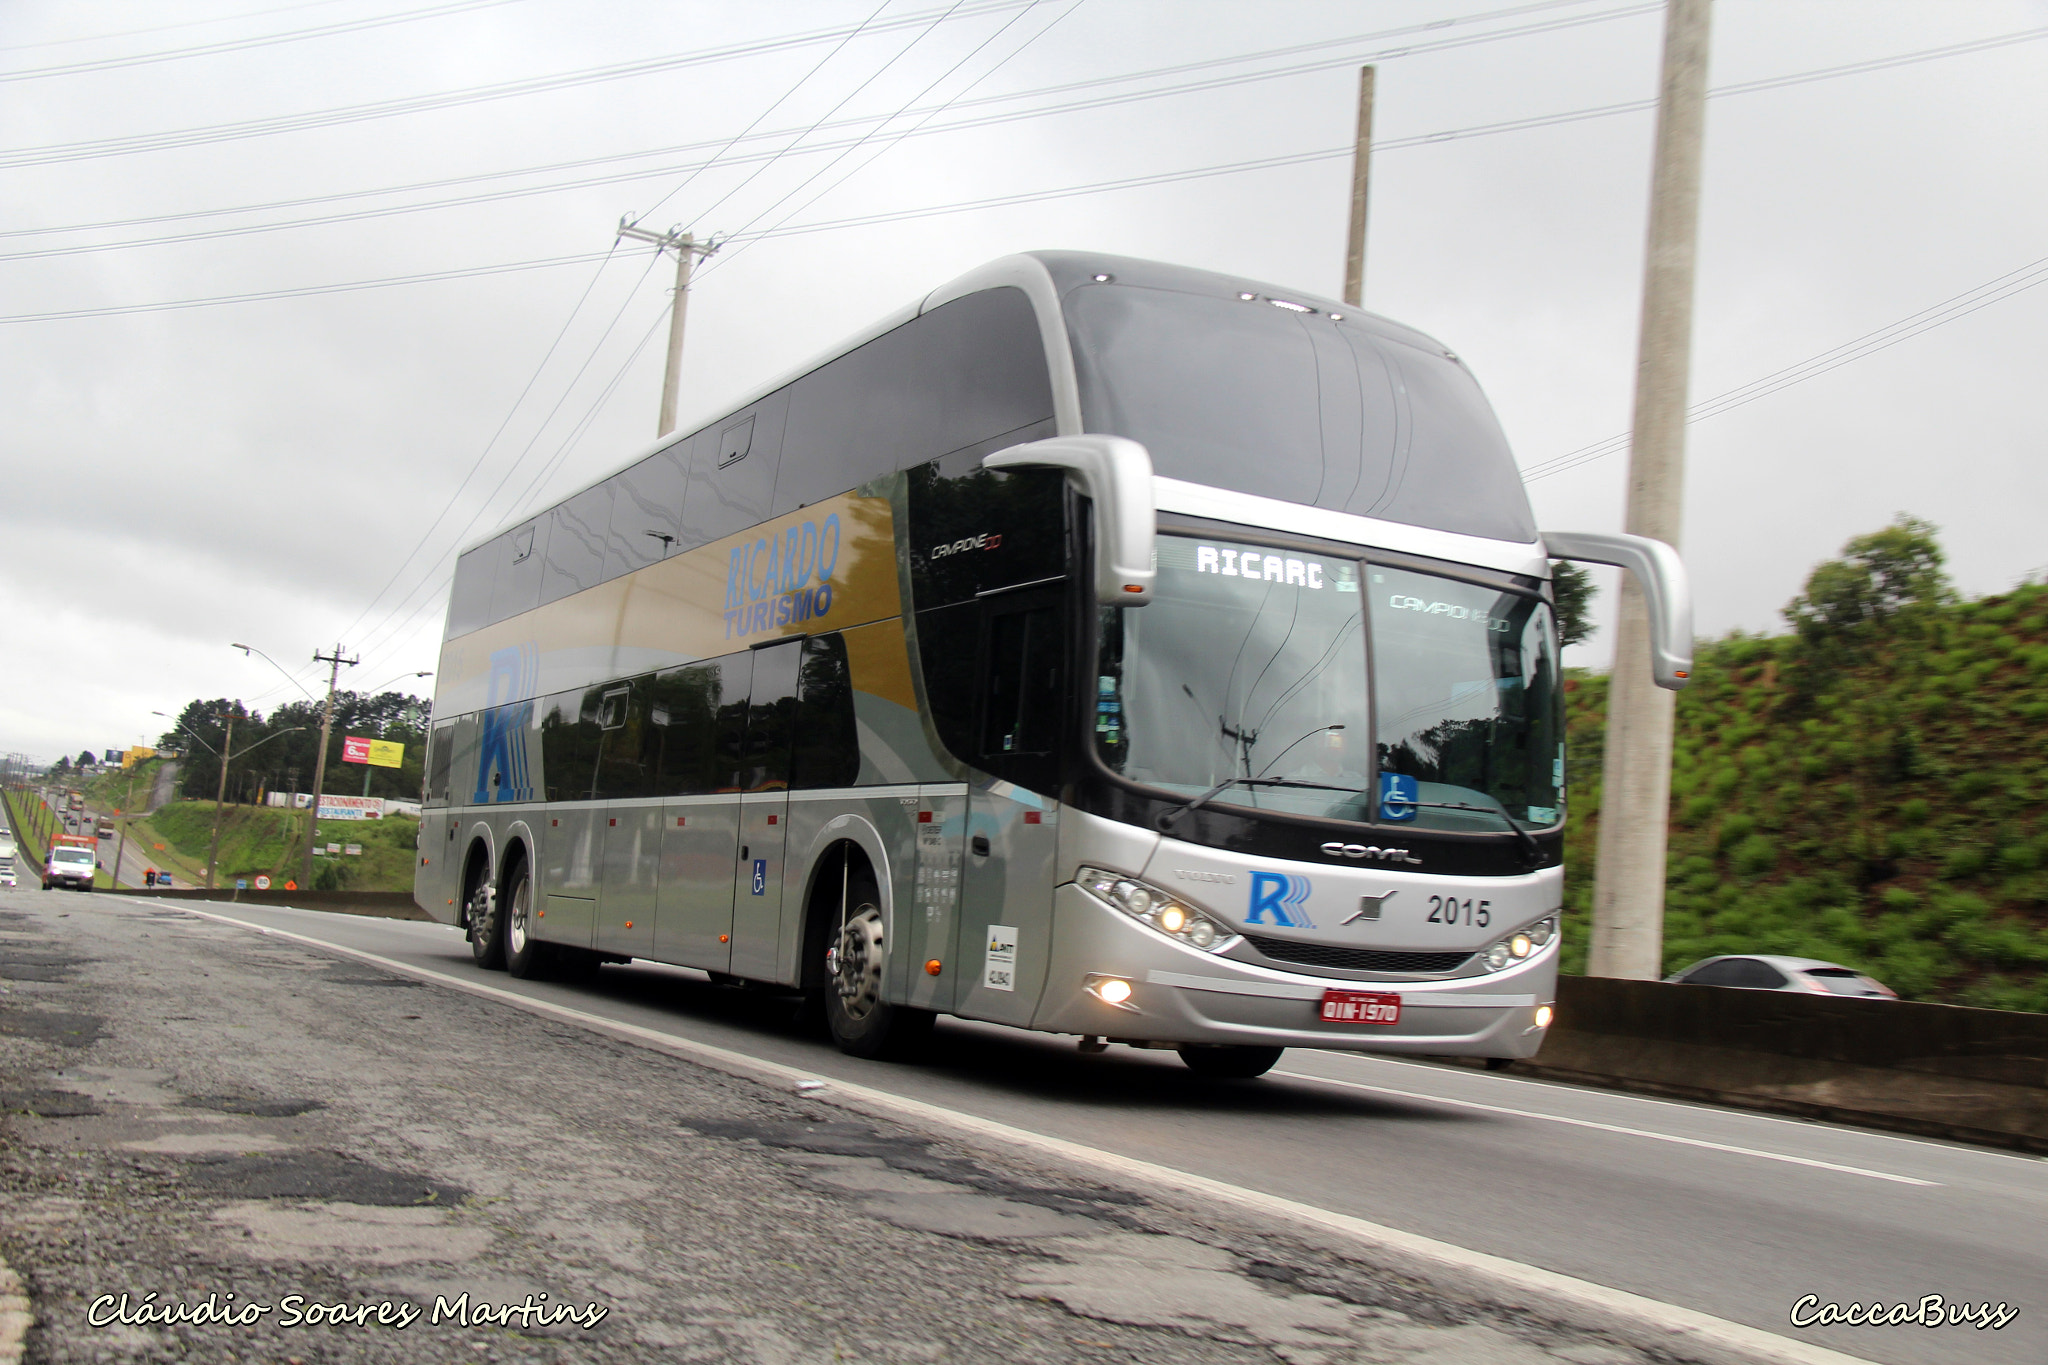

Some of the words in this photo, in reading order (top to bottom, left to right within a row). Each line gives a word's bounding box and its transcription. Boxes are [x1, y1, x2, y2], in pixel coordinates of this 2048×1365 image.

[724, 512, 840, 610] RICARDO
[723, 584, 832, 640] TURISMO
[1320, 842, 1423, 865] COMIL
[1427, 895, 1491, 928] 2015
